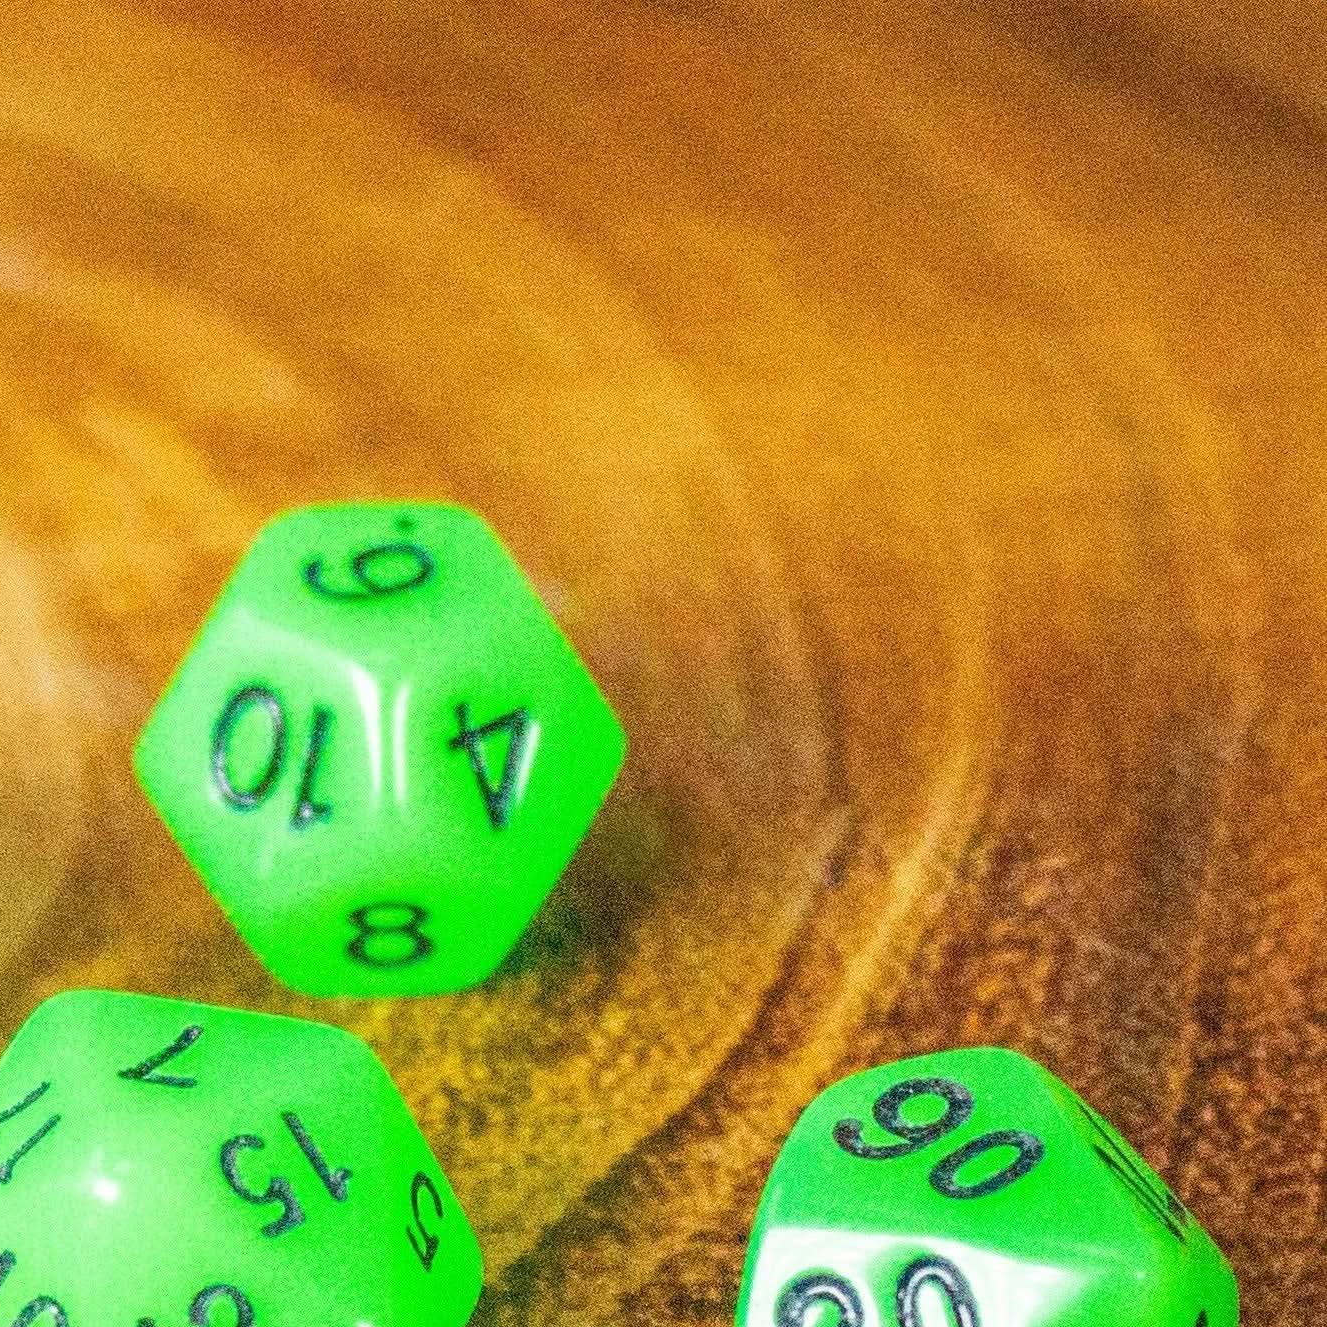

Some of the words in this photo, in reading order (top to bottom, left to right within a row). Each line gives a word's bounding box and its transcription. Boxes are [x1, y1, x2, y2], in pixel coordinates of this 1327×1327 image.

[210, 682, 335, 831] 10
[448, 702, 530, 831] 4
[344, 902, 434, 970] 8
[118, 1026, 203, 1088] 7
[219, 1111, 353, 1239] 15
[832, 1077, 1046, 1200] 90
